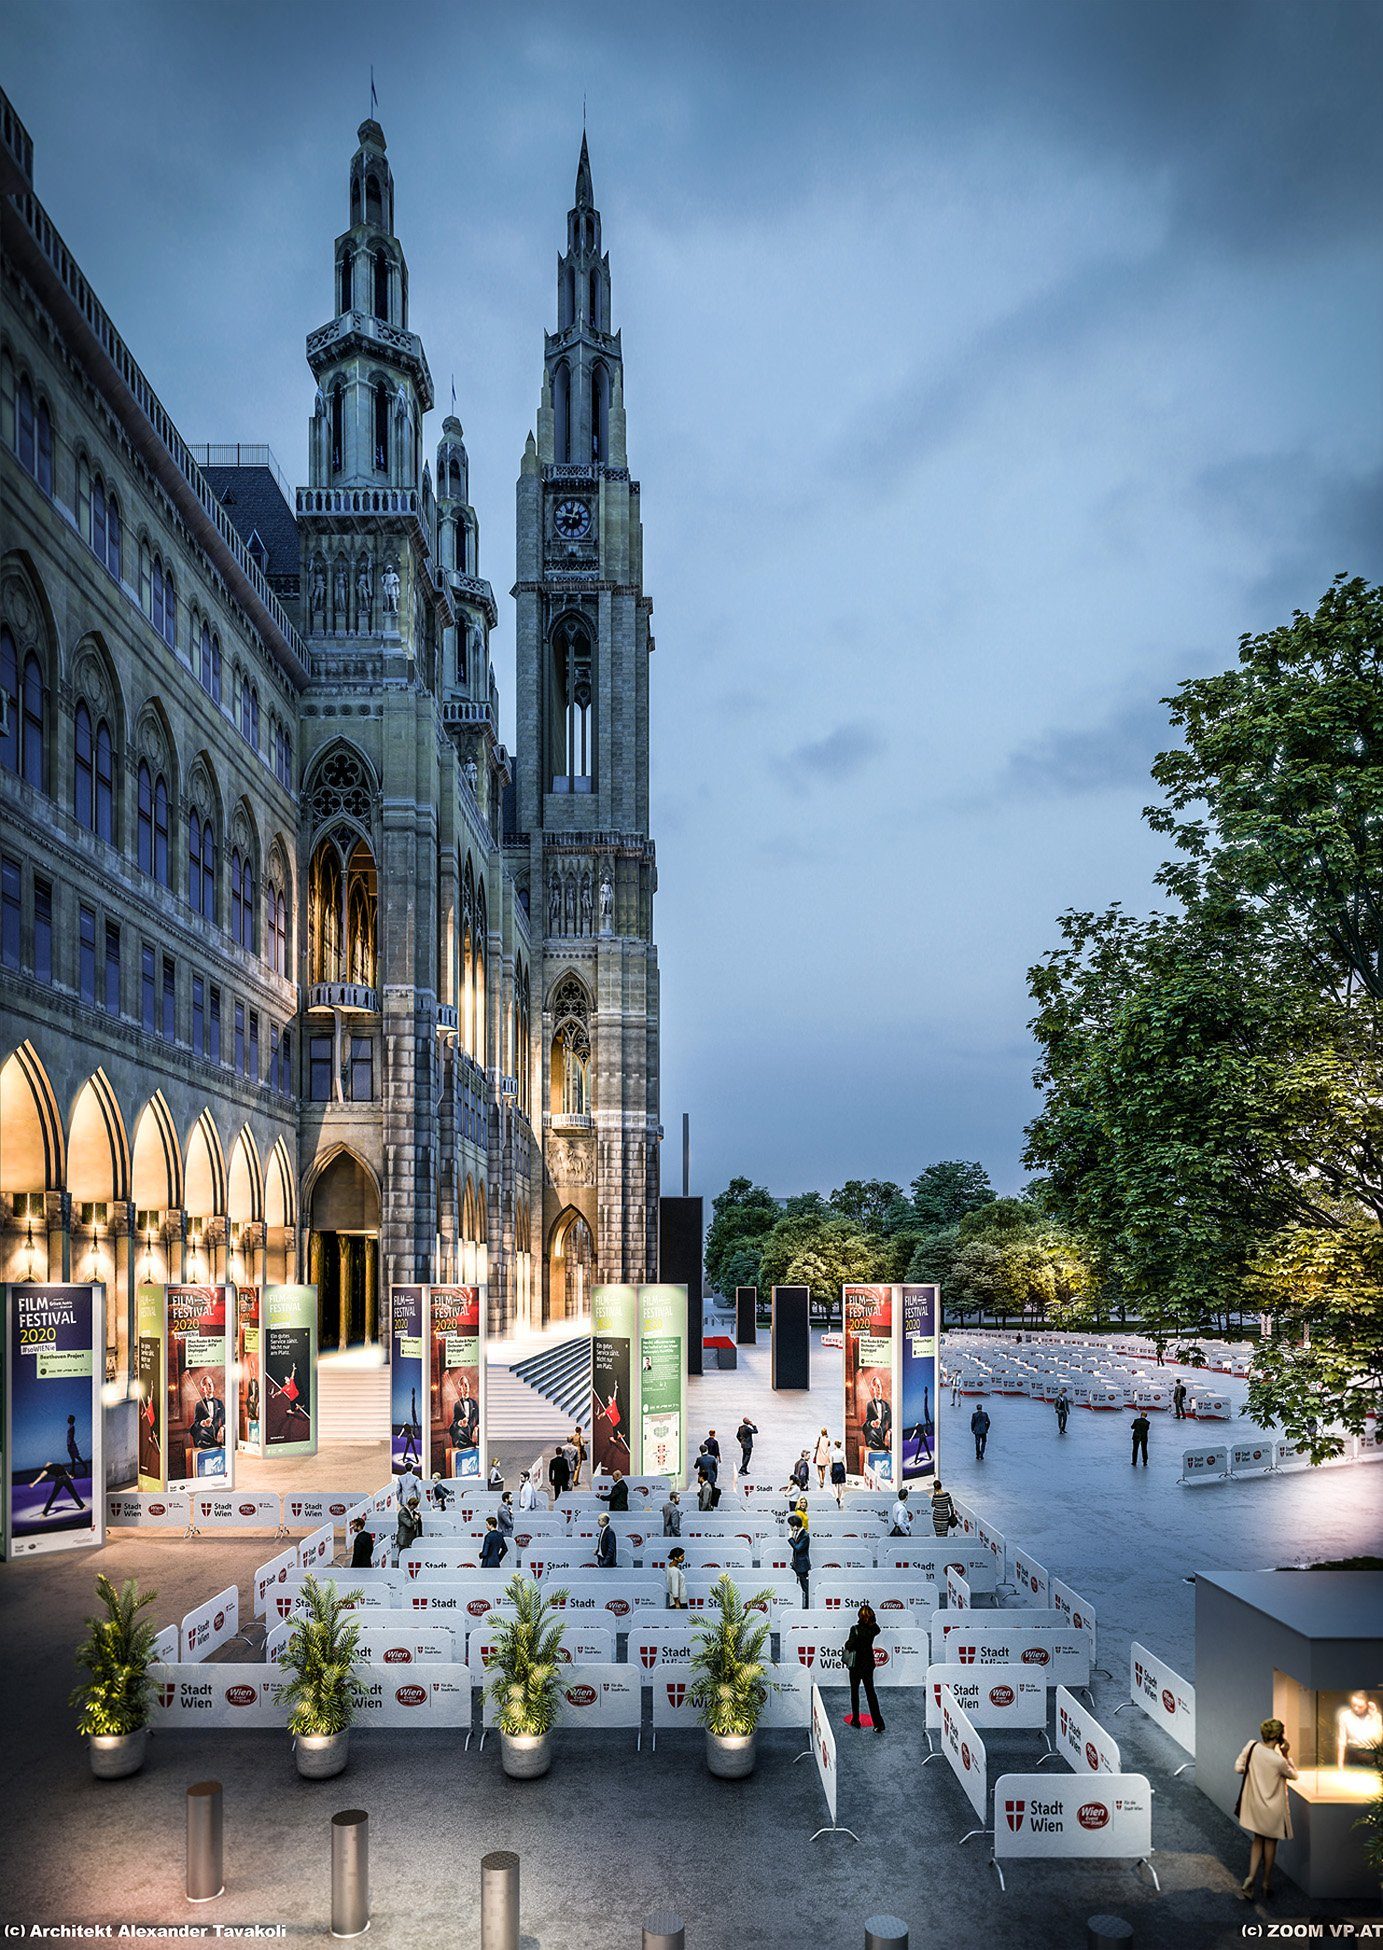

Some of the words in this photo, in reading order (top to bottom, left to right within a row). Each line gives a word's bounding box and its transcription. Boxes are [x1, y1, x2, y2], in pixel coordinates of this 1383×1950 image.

[18, 1297, 48, 1312] FILM
[173, 1295, 194, 1306] FILM
[394, 1295, 406, 1305] FILM
[434, 1296, 452, 1306] FILM
[849, 1296, 866, 1306] FILM
[905, 1295, 918, 1306] FILM
[173, 1306, 214, 1318] FESTIVAL
[394, 1306, 416, 1318] FESTIVAL
[435, 1306, 469, 1318] FESTIVAL
[850, 1306, 882, 1318] FESTIVAL
[906, 1306, 928, 1318] FESTIVAL
[20, 1311, 76, 1328] FESTIVAL
[174, 1319, 200, 1330] 2020
[394, 1319, 408, 1330] 2020
[436, 1319, 458, 1330] 2020
[850, 1318, 870, 1330] 2020
[906, 1319, 920, 1330] 2020
[20, 1328, 56, 1343] 2020
[432, 1599, 457, 1608] Stadt
[570, 1599, 595, 1608] Stadt
[845, 1599, 870, 1608] Stadt
[198, 1620, 210, 1636] Stadt
[662, 1647, 690, 1657] Stadt
[980, 1647, 1009, 1657] Stadt
[1144, 1670, 1158, 1690] Stadt
[181, 1683, 212, 1695] Stadt
[954, 1684, 979, 1695] Stadt
[1144, 1682, 1158, 1702] Wien
[181, 1697, 212, 1708] Wien
[352, 1697, 382, 1708] Wien
[1068, 1718, 1081, 1740] Stadt
[1068, 1732, 1081, 1756] Wien
[1031, 1801, 1063, 1815] Stadt
[1081, 1808, 1104, 1816] Wien
[1031, 1818, 1063, 1832] Wien
